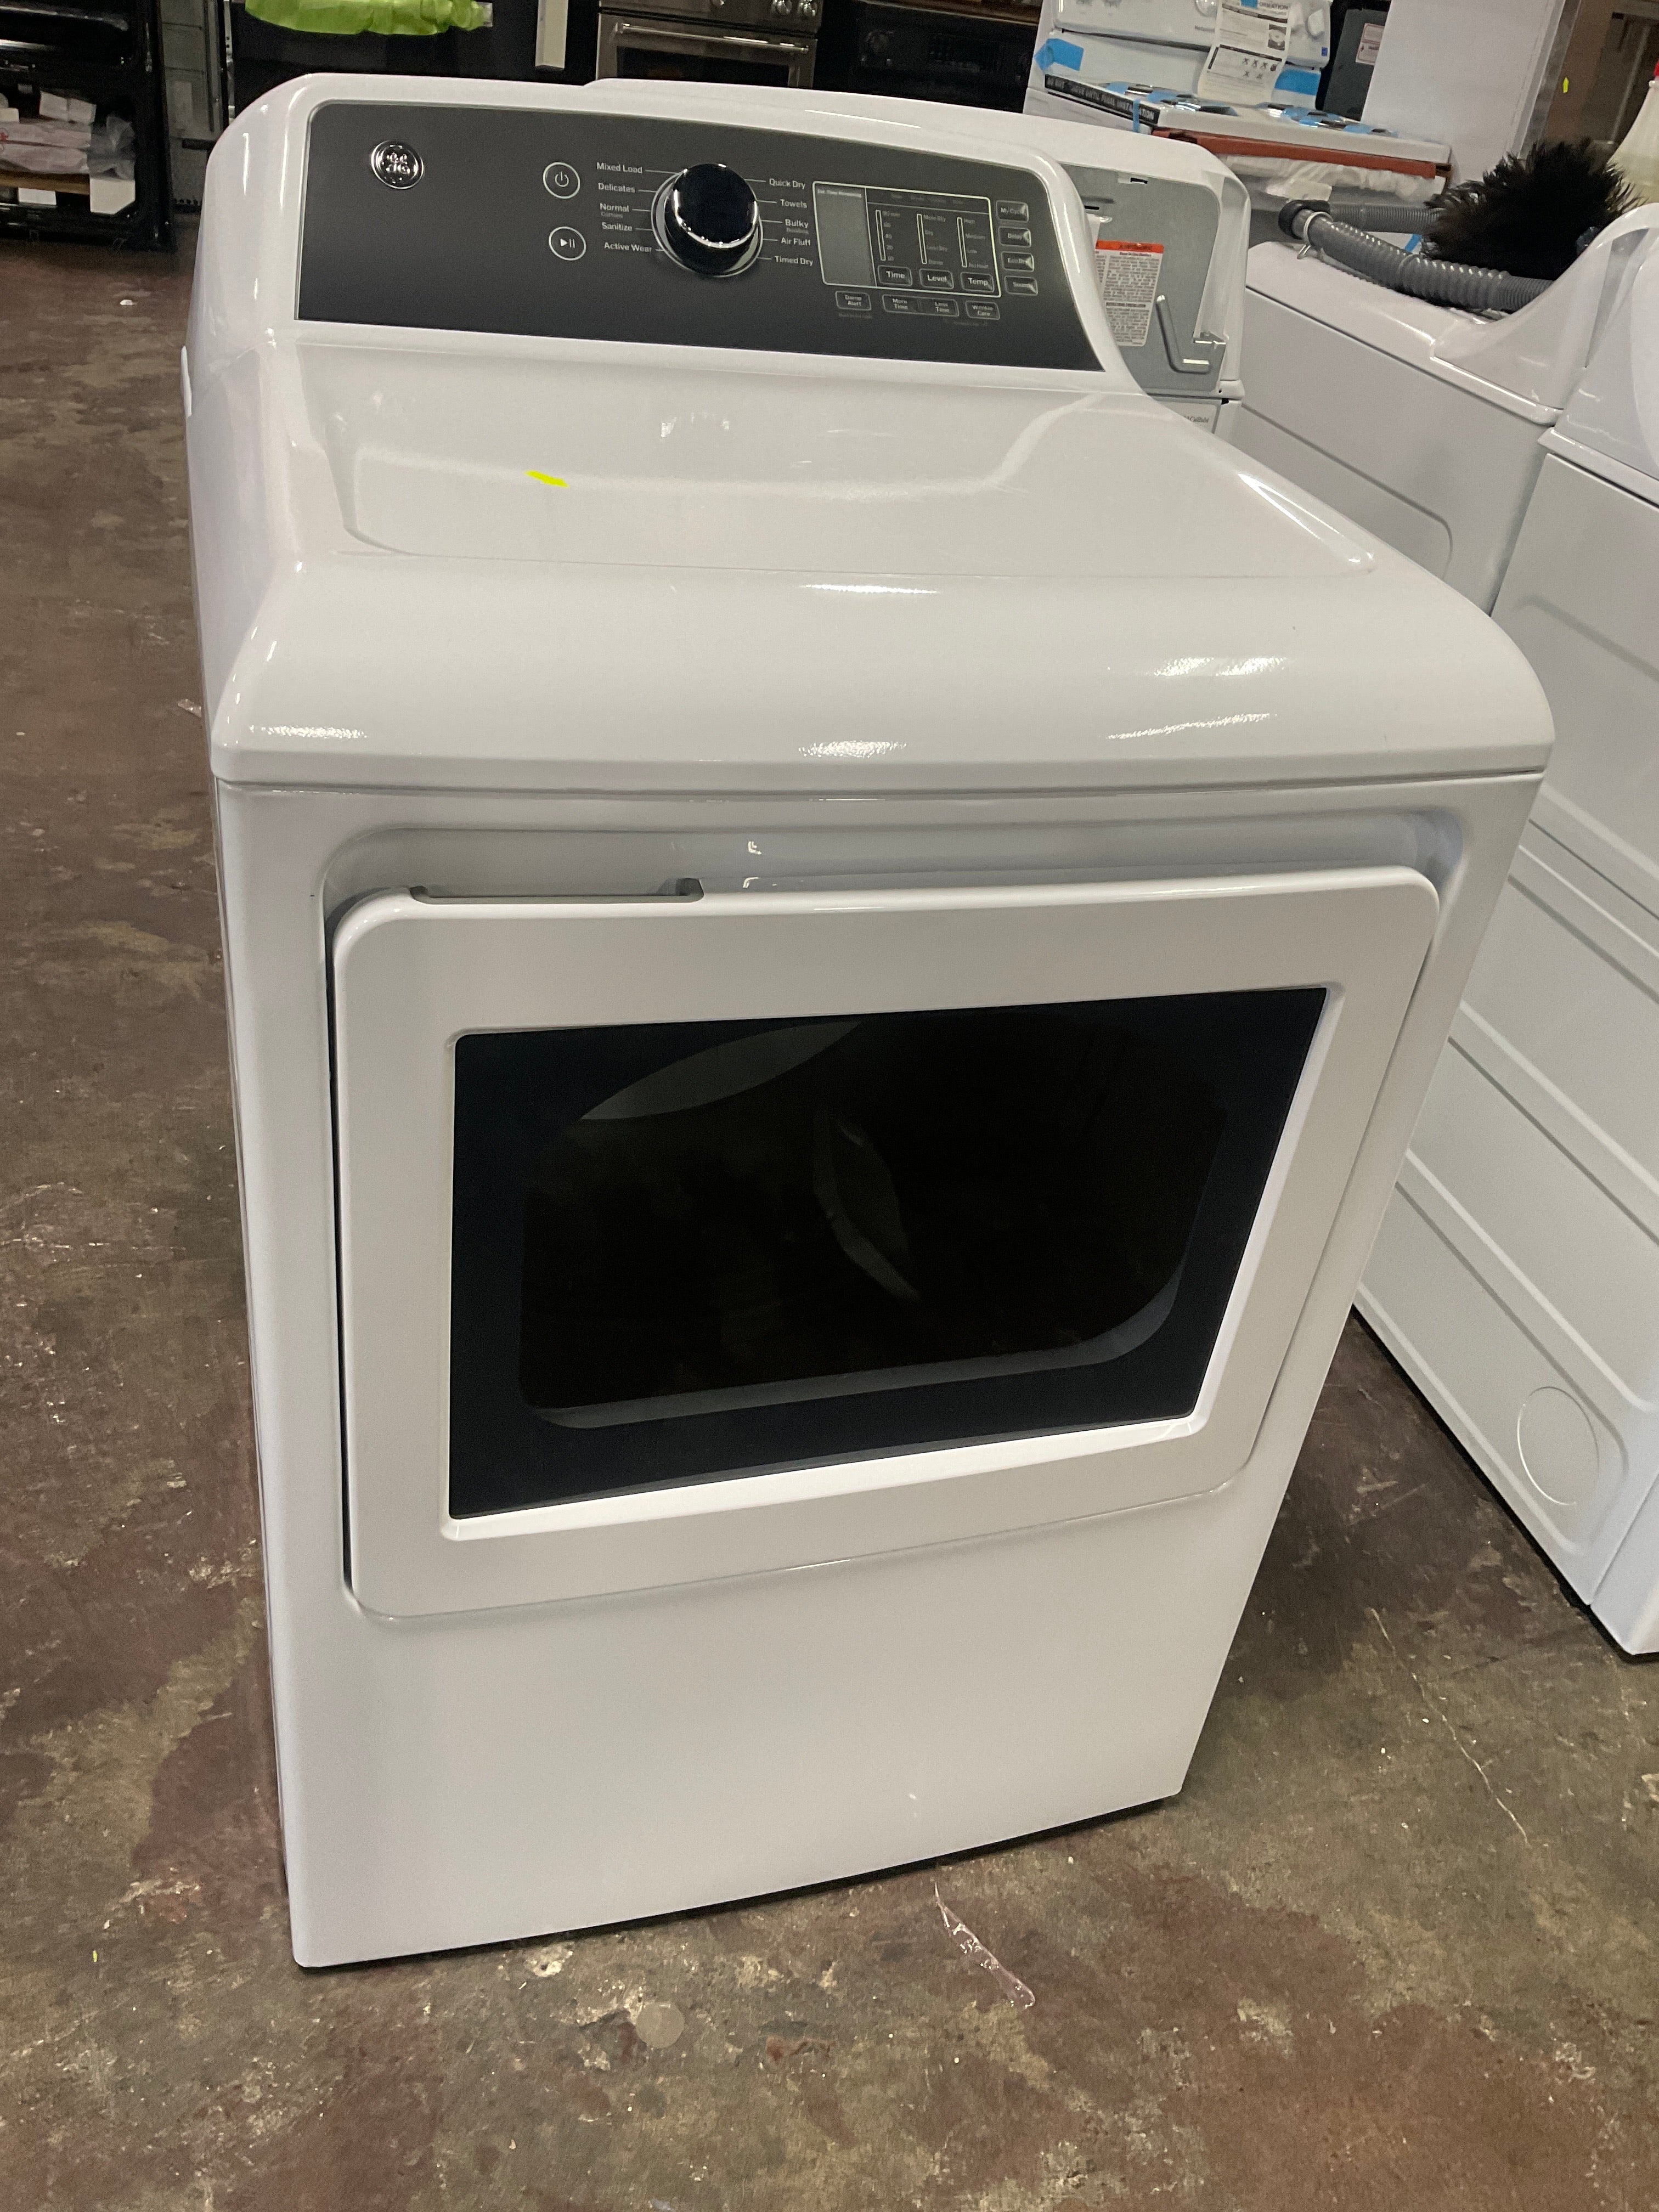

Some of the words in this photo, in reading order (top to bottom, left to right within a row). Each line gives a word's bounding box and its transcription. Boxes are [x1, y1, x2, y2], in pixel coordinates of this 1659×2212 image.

[596, 162, 621, 172] Mixed
[623, 164, 643, 174] Load
[598, 182, 635, 193] Delicates
[769, 178, 791, 187] Quick
[792, 180, 805, 190] Dry
[600, 202, 629, 212] Normal
[780, 199, 808, 208] Towels
[602, 222, 633, 232] Sanitize
[785, 218, 809, 228] Bulky
[604, 241, 630, 251] Active
[631, 244, 652, 252] Wear
[793, 238, 811, 246] Fluff
[774, 255, 799, 264] Timed
[800, 257, 813, 266] Dry
[885, 270, 905, 279] Time
[927, 274, 947, 283] Level
[967, 277, 989, 286] Temp
